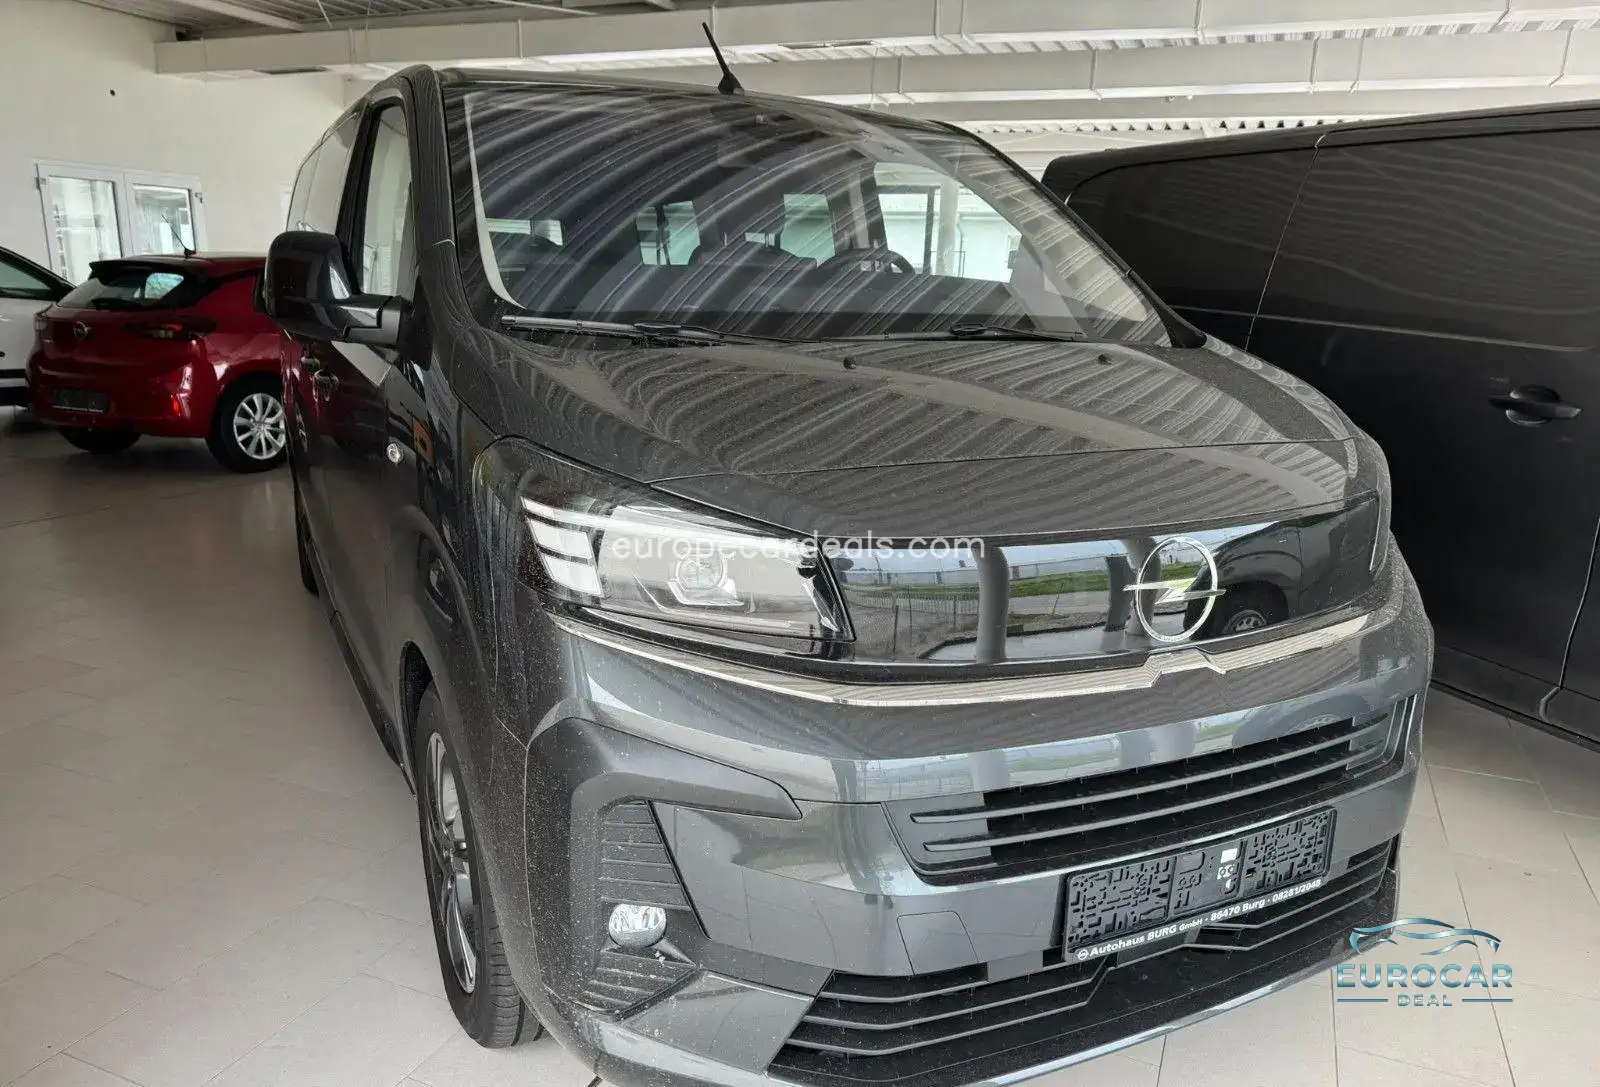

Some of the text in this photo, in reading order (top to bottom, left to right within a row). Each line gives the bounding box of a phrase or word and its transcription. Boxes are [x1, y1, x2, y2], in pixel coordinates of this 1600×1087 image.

[1089, 935, 1146, 957] Autohaus
[1147, 924, 1177, 941] BURG
[1179, 918, 1203, 931] GmbH
[1242, 898, 1265, 912] Burg
